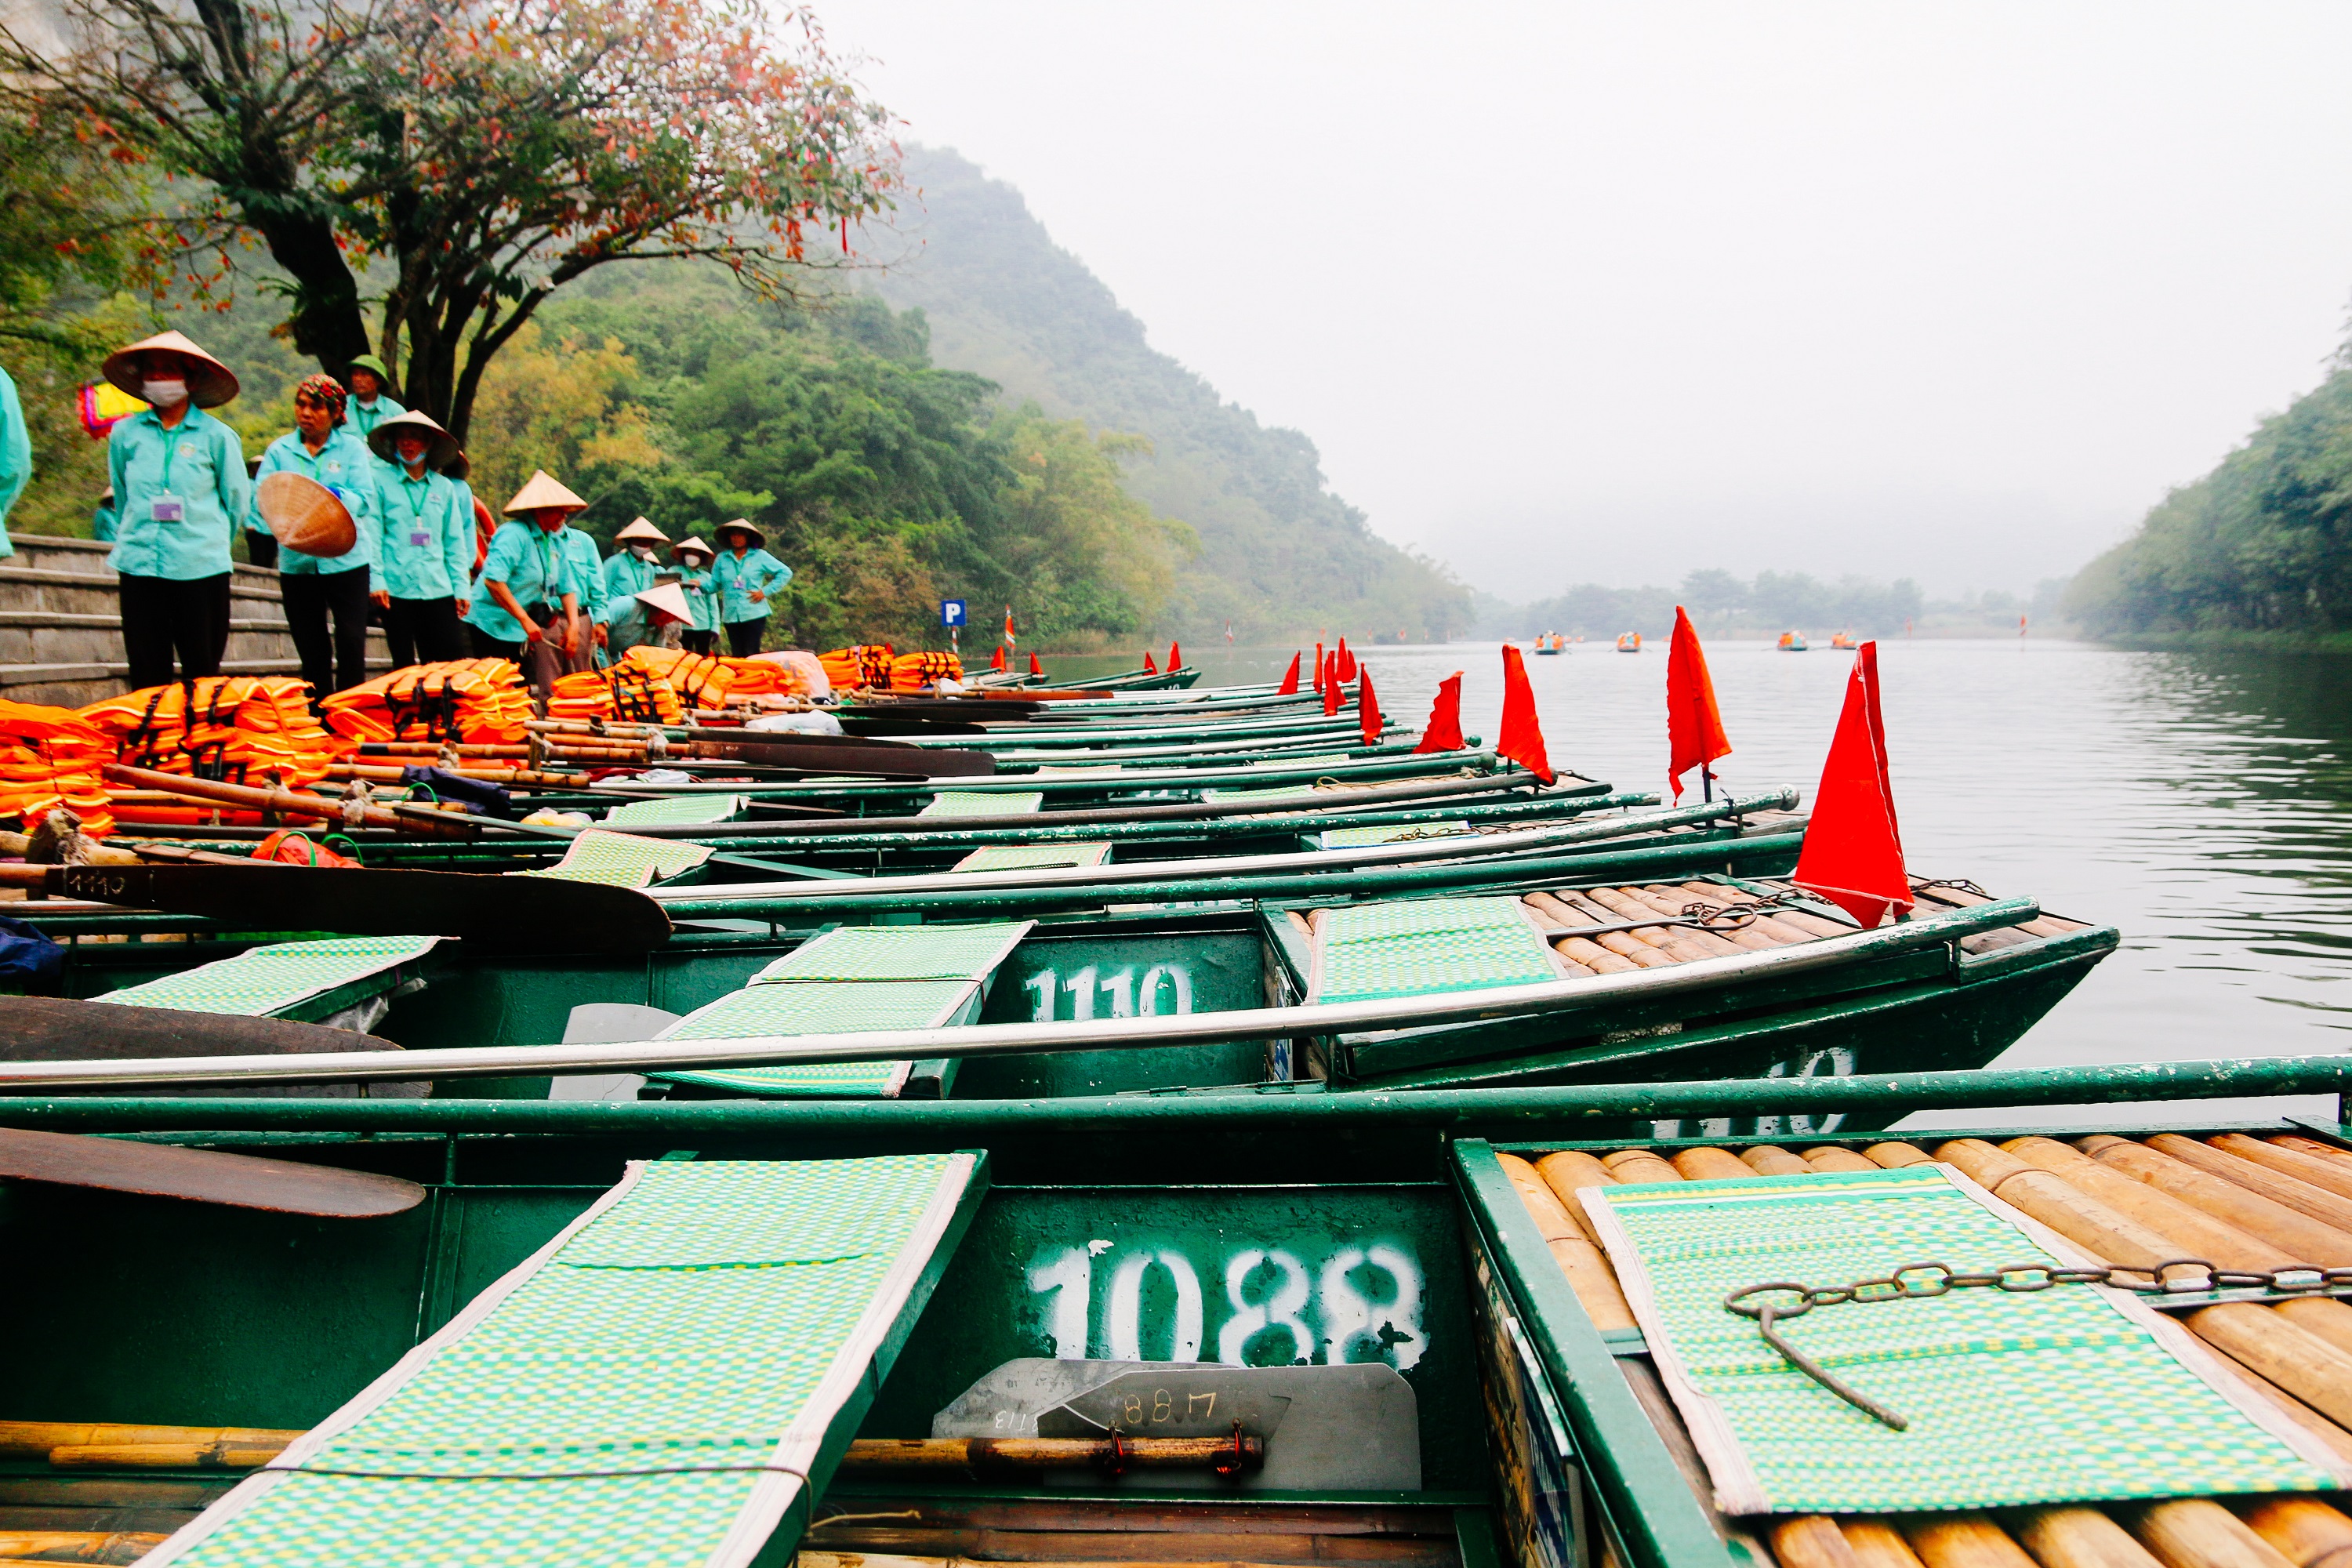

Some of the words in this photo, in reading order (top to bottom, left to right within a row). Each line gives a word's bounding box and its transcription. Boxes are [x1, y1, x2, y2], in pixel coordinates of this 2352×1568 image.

[946, 603, 961, 624] P
[69, 873, 125, 896] 1110
[1025, 964, 1193, 1022] 1110
[1027, 1245, 1430, 1373] 1088
